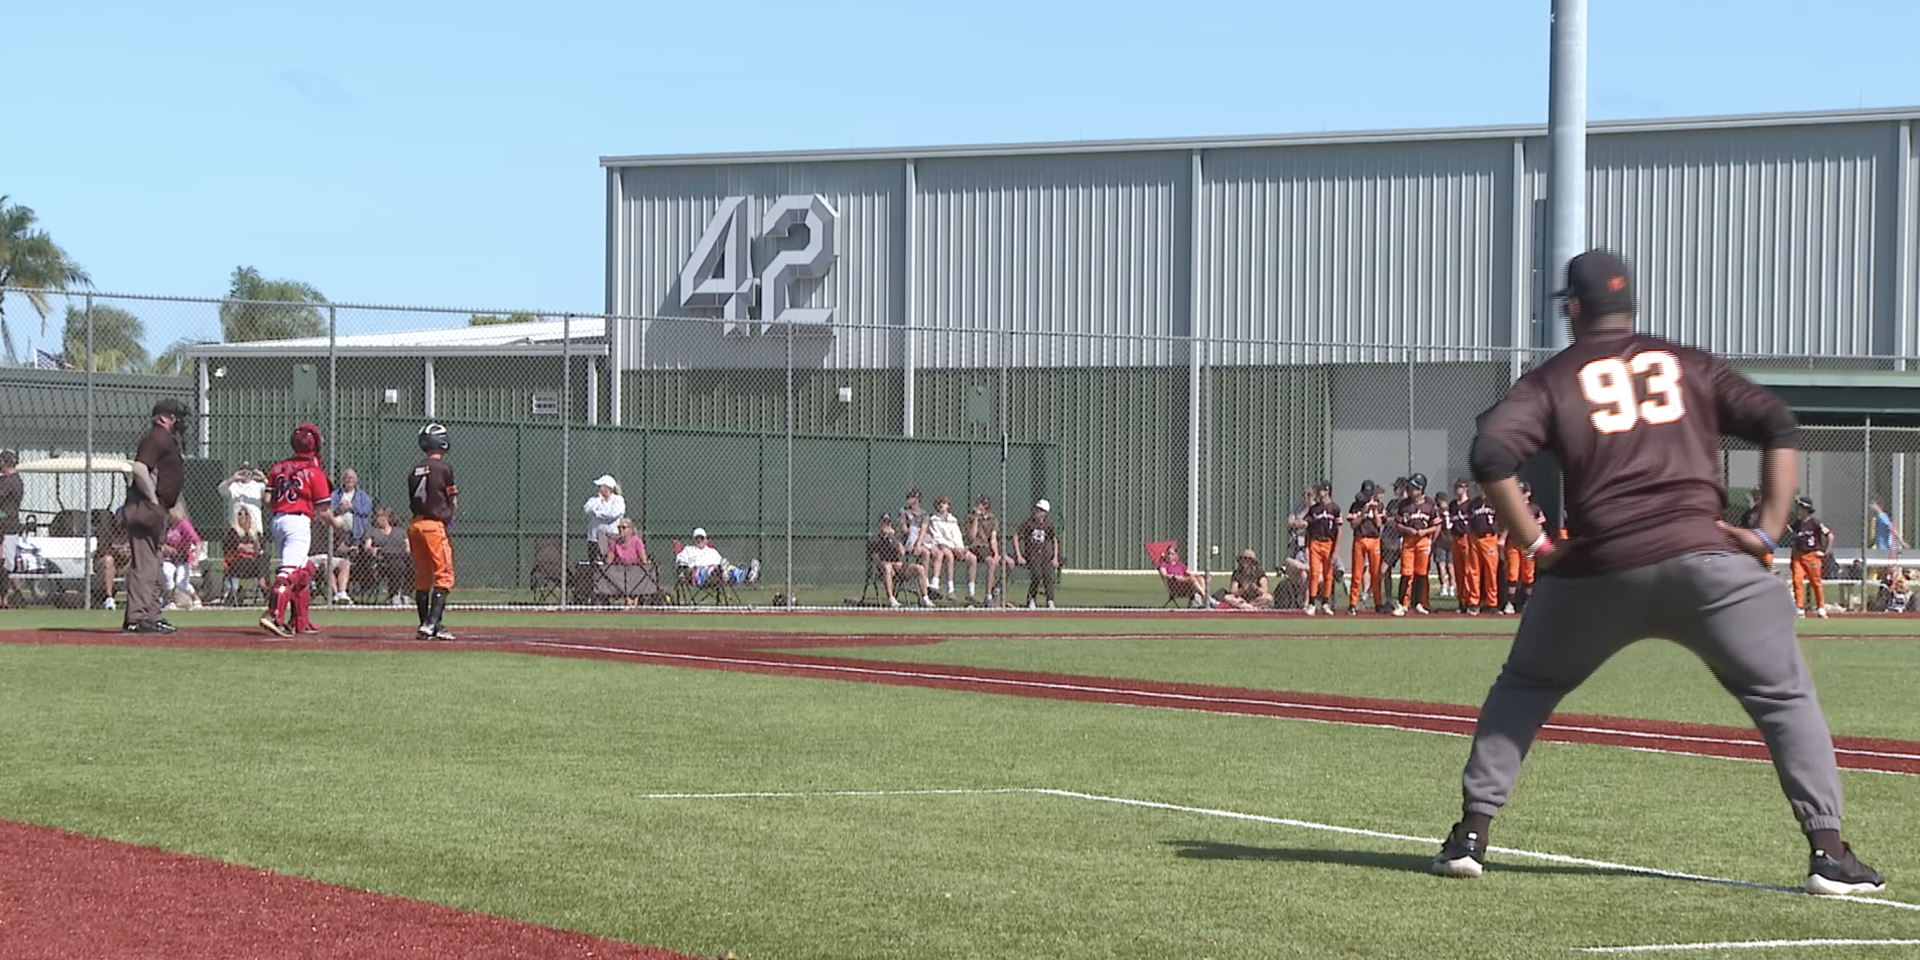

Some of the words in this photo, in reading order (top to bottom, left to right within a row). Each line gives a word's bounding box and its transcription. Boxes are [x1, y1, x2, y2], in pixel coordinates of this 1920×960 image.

[680, 194, 839, 337] 42
[1577, 349, 1685, 435] 93
[413, 476, 427, 504] 4
